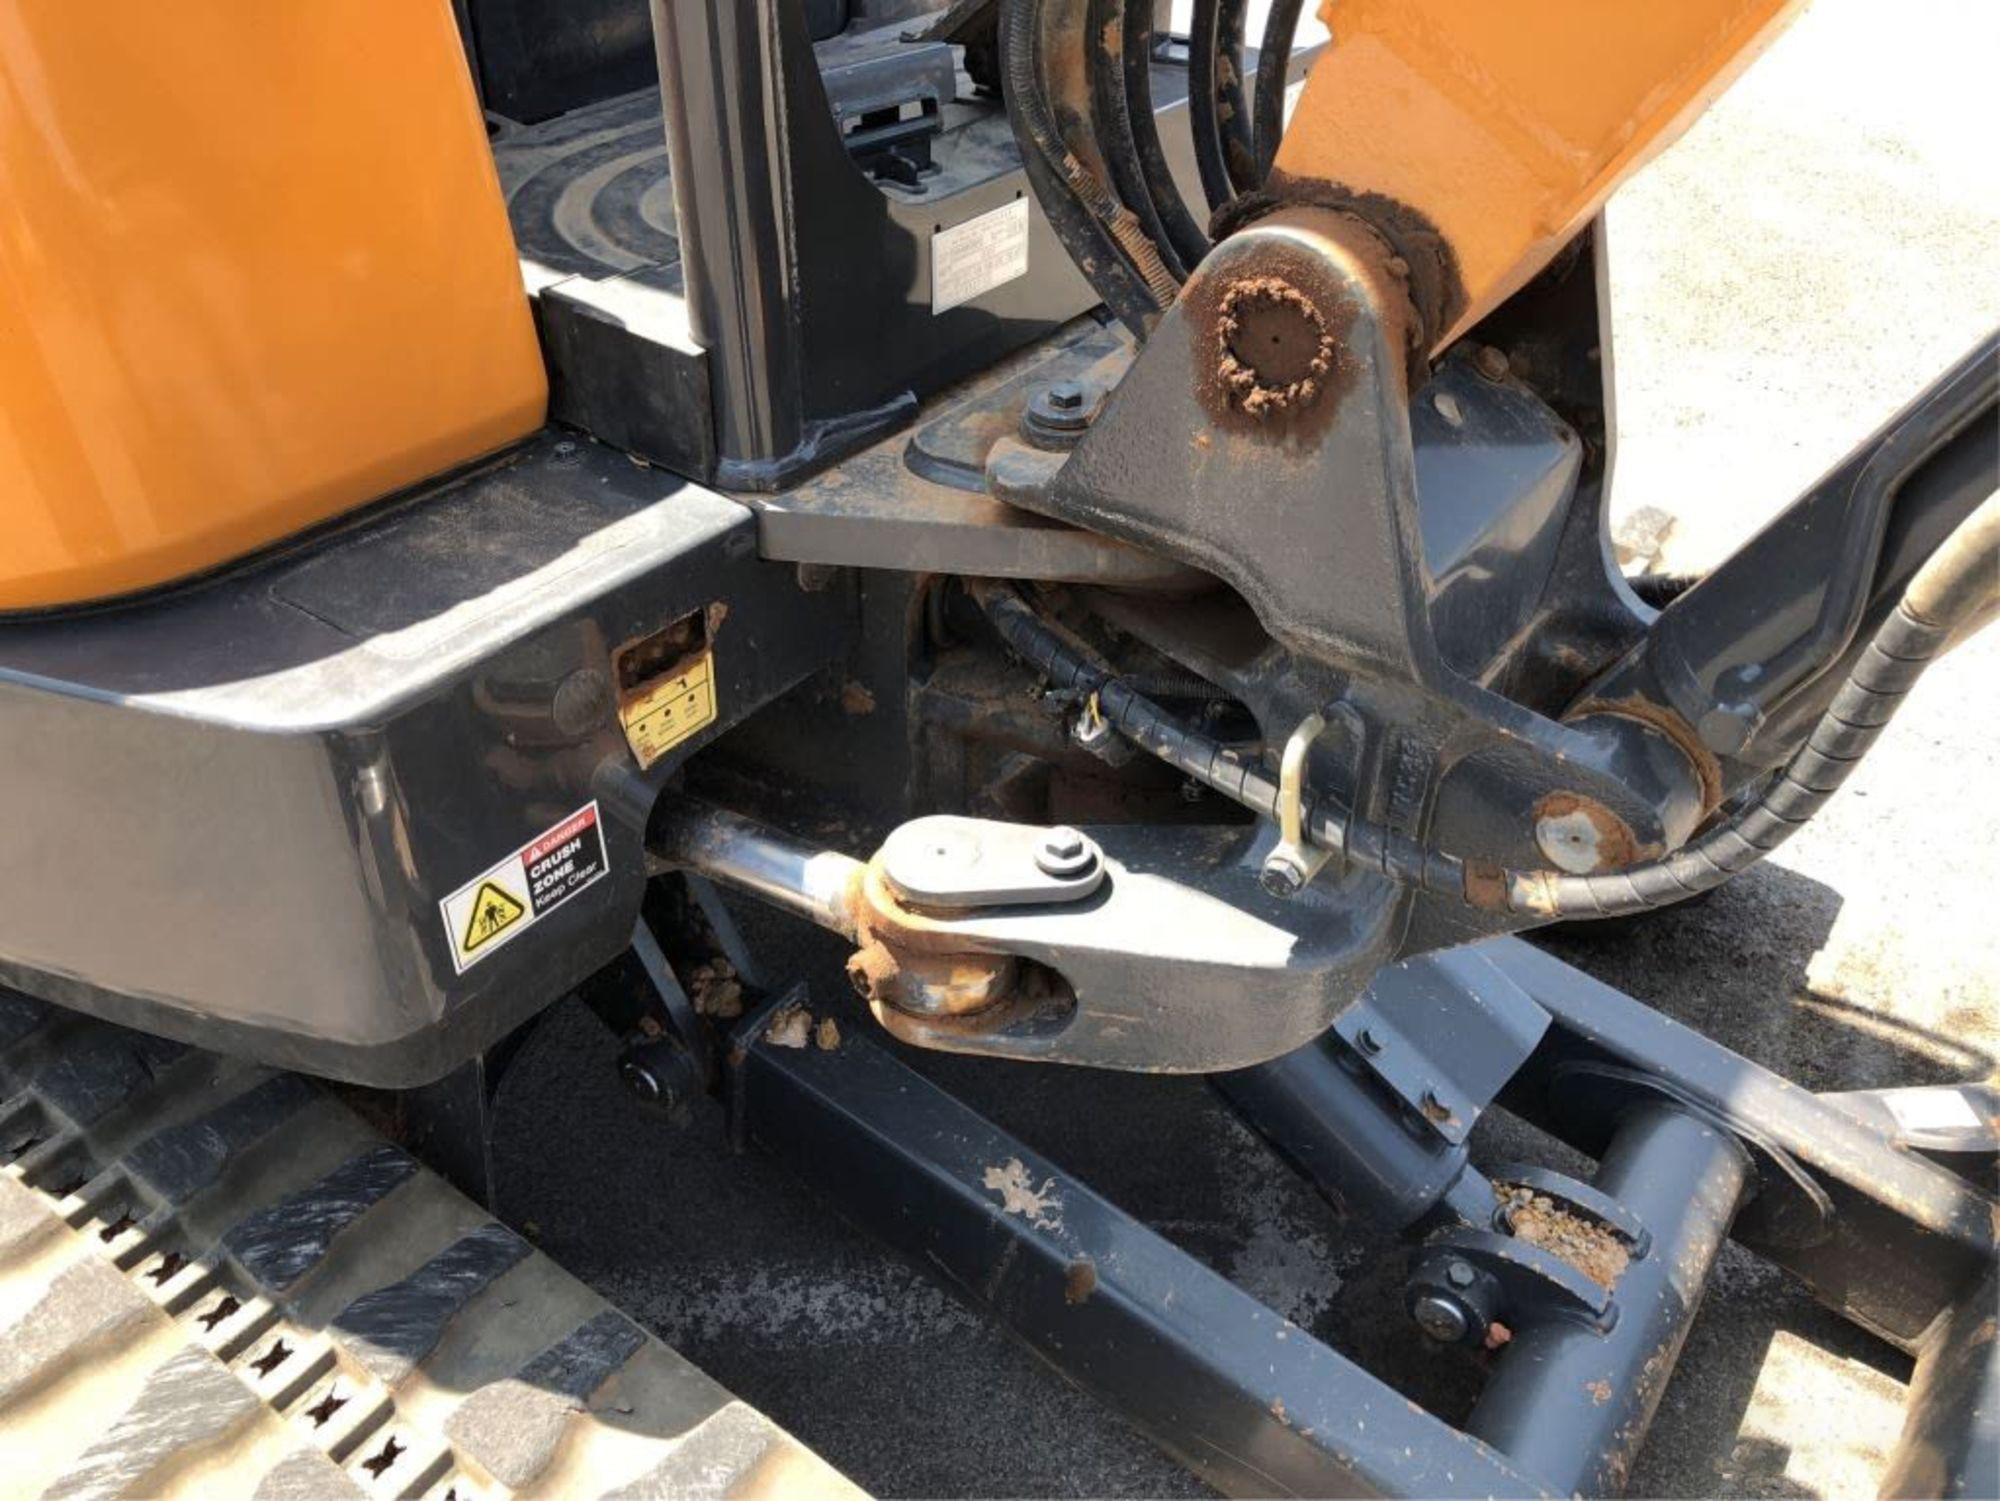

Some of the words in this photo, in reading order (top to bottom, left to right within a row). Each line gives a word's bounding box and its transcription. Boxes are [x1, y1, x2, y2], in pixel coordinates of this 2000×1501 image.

[542, 818, 586, 851] DANGER
[530, 837, 582, 879] CRUSH
[533, 861, 575, 896] ZONE
[535, 884, 567, 909] Keep
[568, 861, 598, 886] Clear
